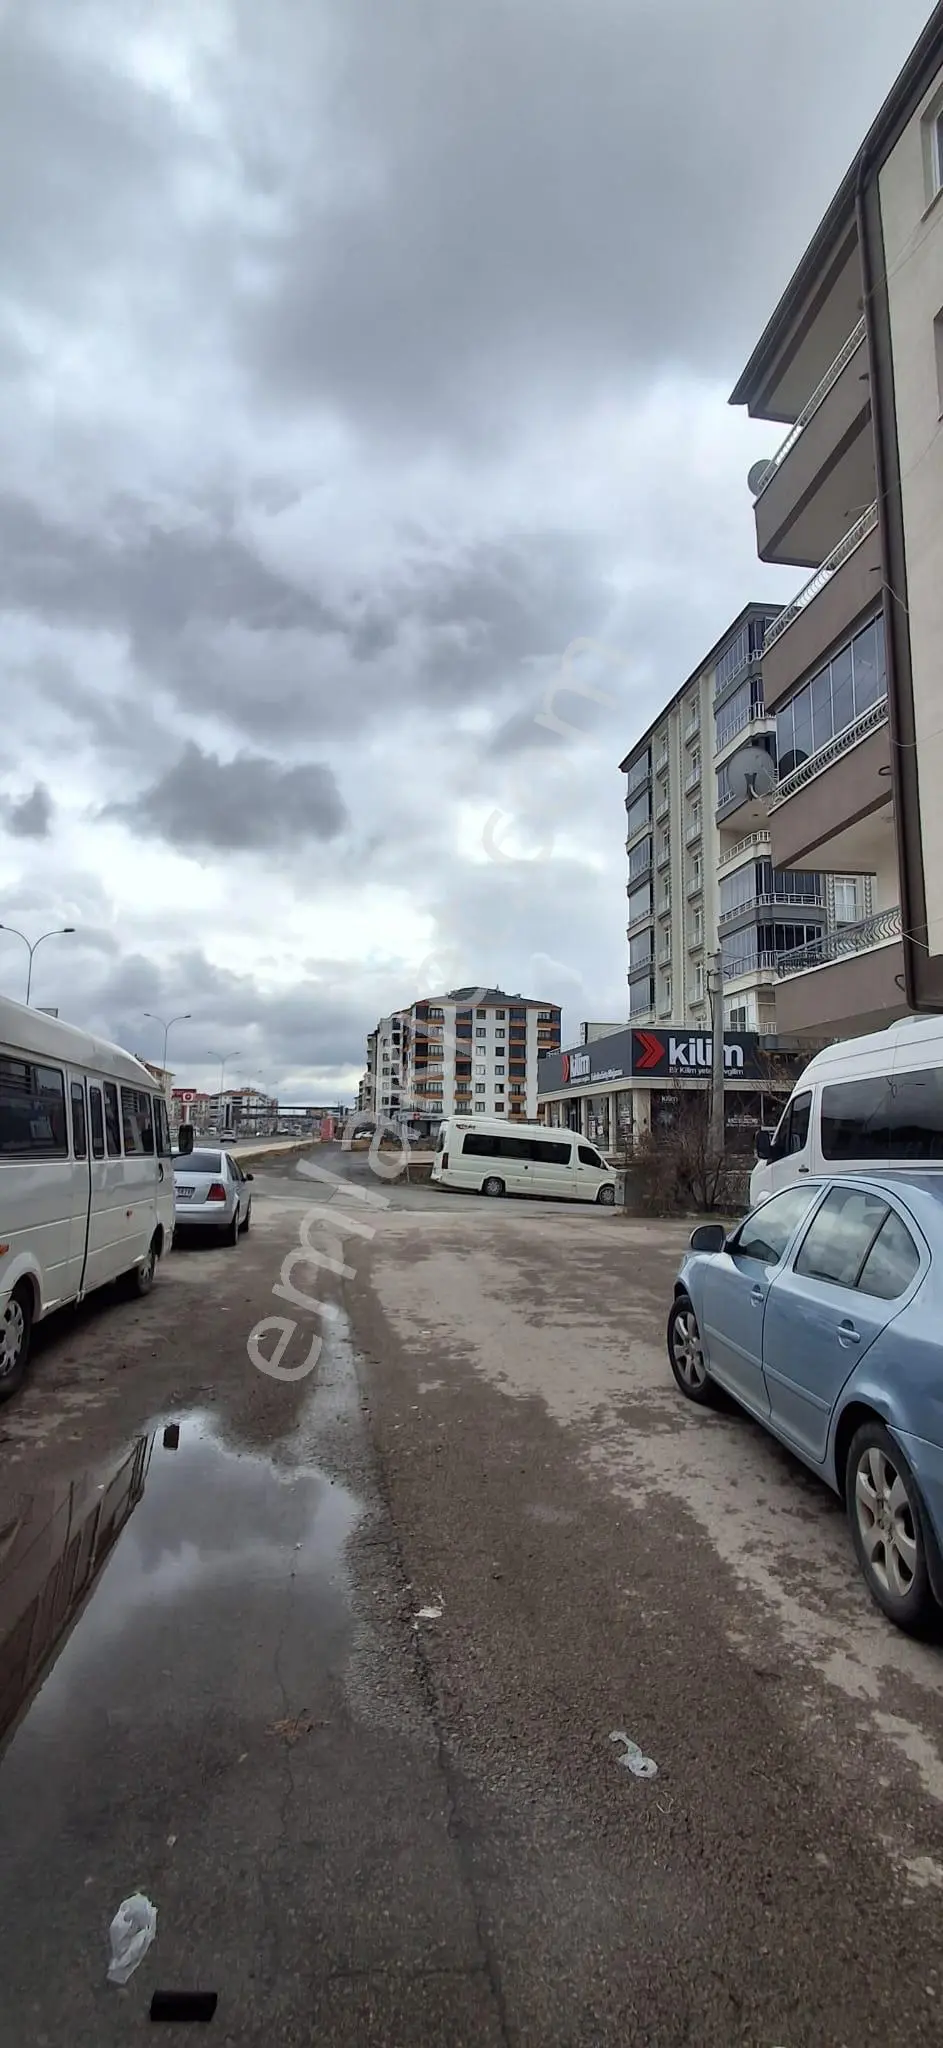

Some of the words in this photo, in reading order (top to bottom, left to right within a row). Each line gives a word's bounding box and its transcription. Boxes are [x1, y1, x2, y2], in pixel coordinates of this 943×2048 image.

[669, 1038, 744, 1067] kilim
[570, 1053, 590, 1078] kilim
[680, 1067, 697, 1075] Kilim
